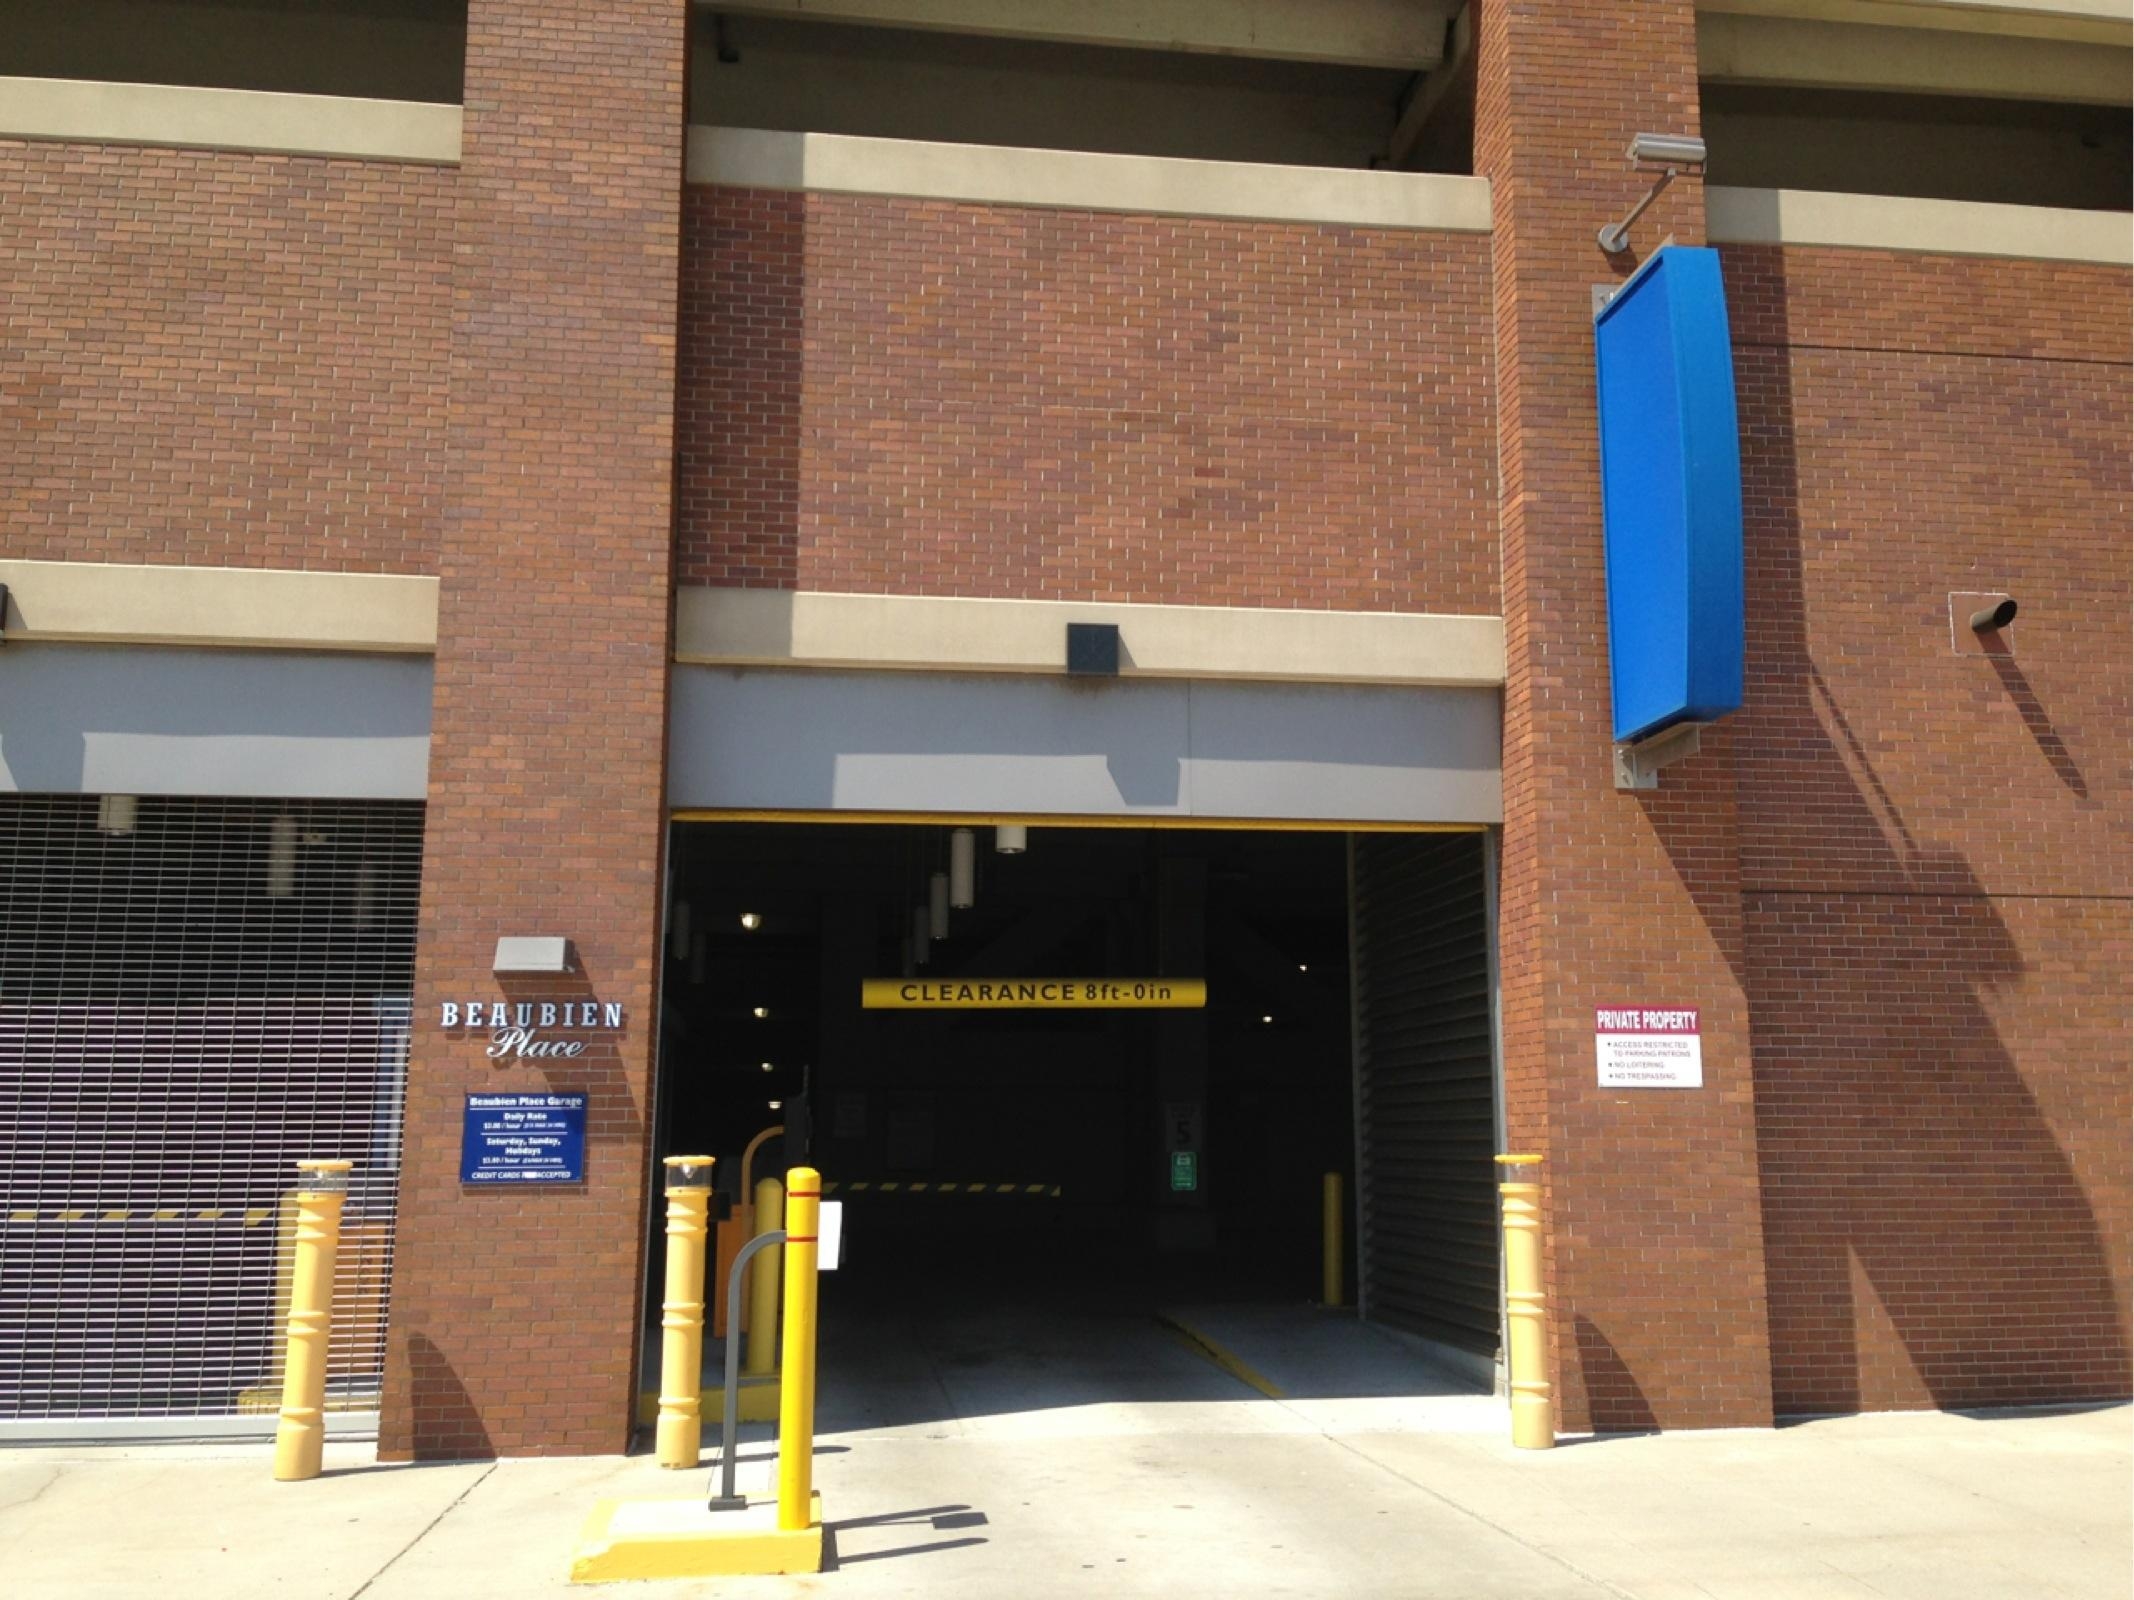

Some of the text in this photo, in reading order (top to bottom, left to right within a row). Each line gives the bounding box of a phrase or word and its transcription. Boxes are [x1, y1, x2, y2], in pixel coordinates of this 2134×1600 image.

[901, 983, 1172, 1001] CLEARANCE 8ft-0in
[440, 1003, 622, 1027] BEAUBIEN
[1597, 1010, 1697, 1029] PRIVATE PROPERTY
[486, 1026, 588, 1058] Place
[470, 1097, 582, 1108] Beaubien Place Garage
[504, 1112, 547, 1122] Daily Rate
[486, 1137, 561, 1147] Saturday, Sunday,
[505, 1147, 541, 1156] Holidays
[472, 1171, 497, 1179] CREDIT
[498, 1171, 520, 1179] CARDS
